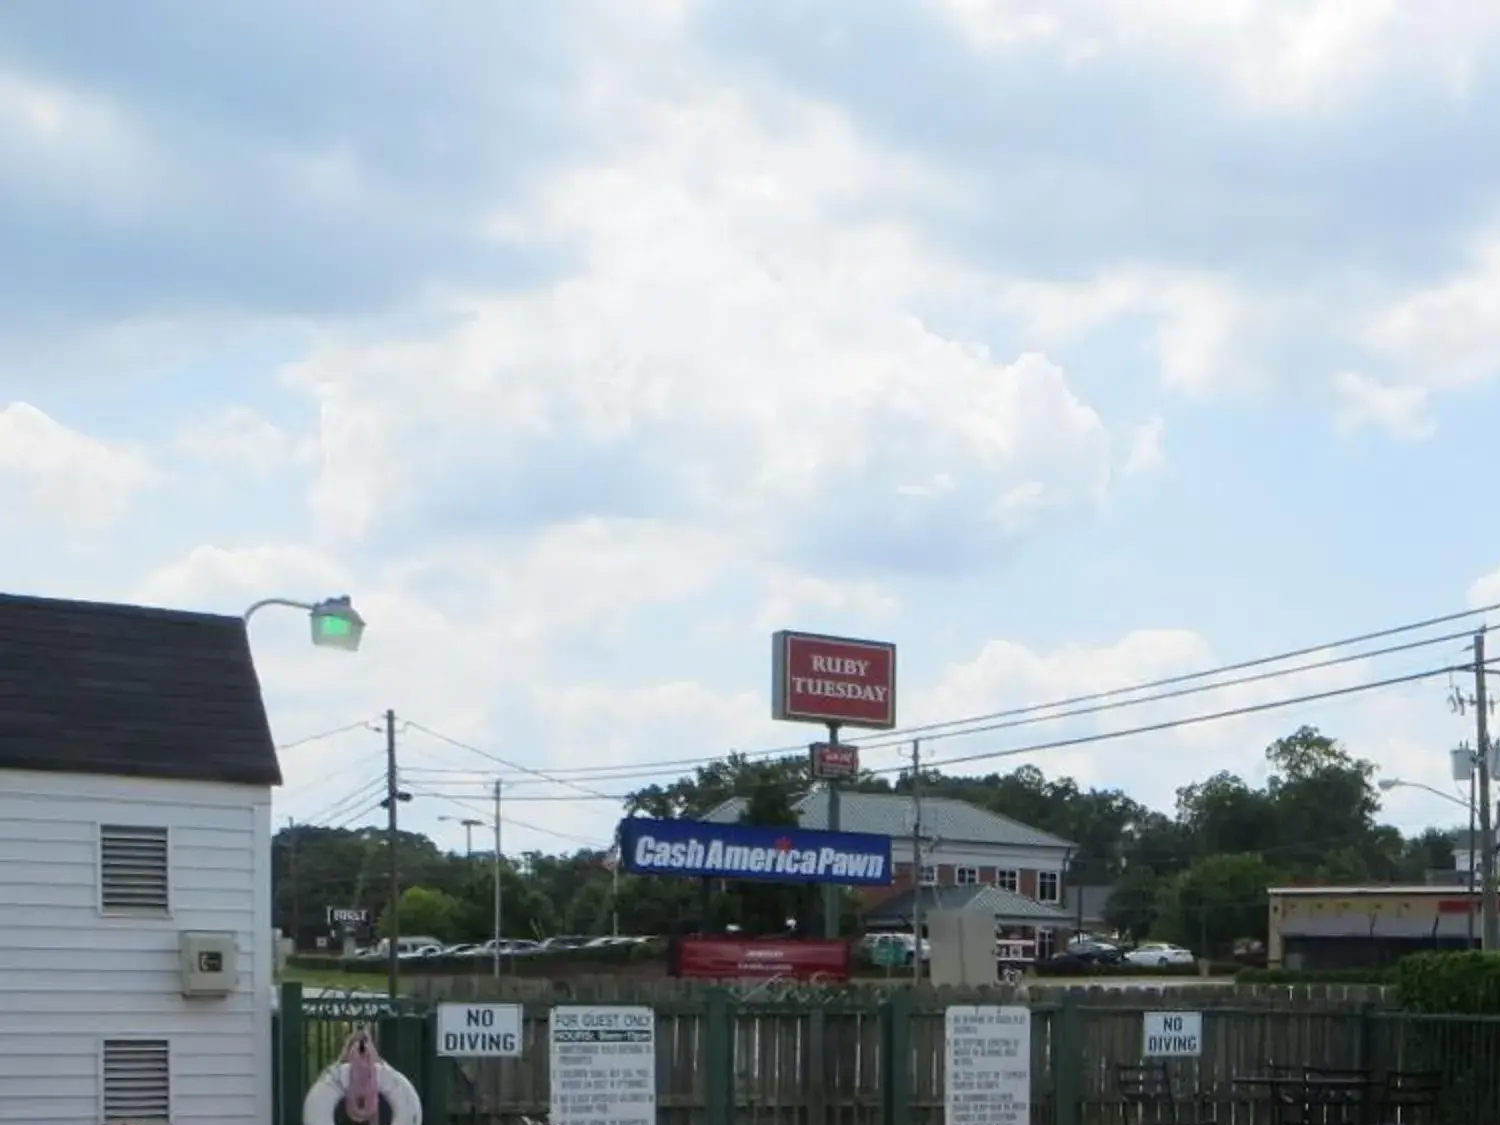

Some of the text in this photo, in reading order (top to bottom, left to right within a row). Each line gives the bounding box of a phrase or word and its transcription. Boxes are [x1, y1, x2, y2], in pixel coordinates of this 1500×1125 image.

[811, 655, 870, 676] RUBY
[792, 677, 888, 703] TUESDAY
[466, 1008, 494, 1027] NO
[555, 1013, 579, 1027] FOR
[582, 1013, 619, 1027] GUEST
[1163, 1015, 1183, 1033] NO
[445, 1032, 516, 1052] DIVING
[1148, 1035, 1197, 1052] DIVING
